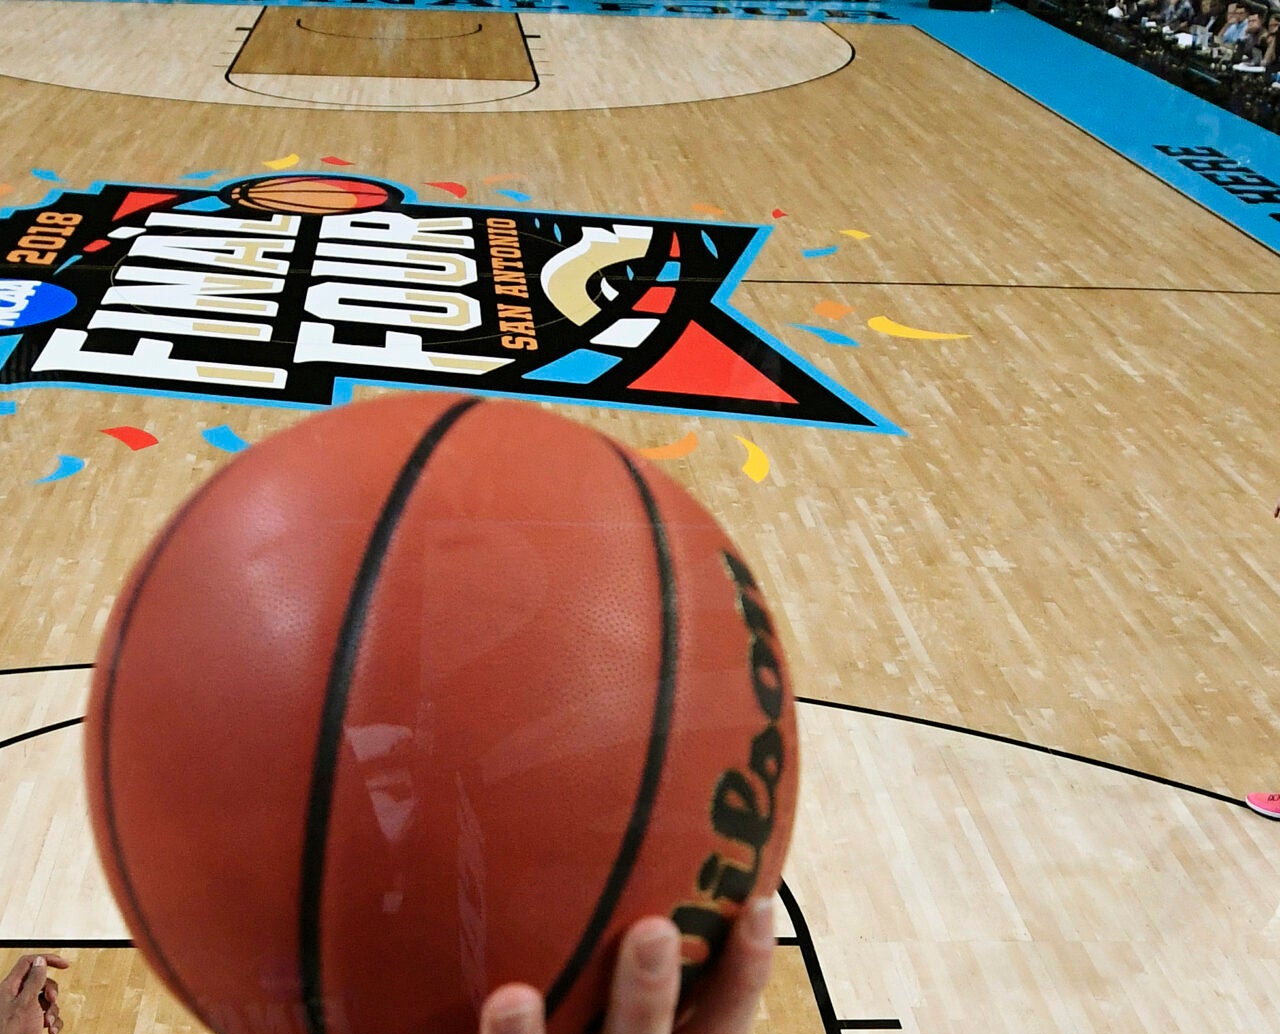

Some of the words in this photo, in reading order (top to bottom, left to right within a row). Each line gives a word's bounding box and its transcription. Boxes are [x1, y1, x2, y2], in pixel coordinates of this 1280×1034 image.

[6, 211, 83, 265] 2018
[486, 217, 529, 299] ANTONIO
[30, 211, 302, 390] FINAL
[293, 211, 516, 376] FOUR
[496, 303, 538, 351] SAN
